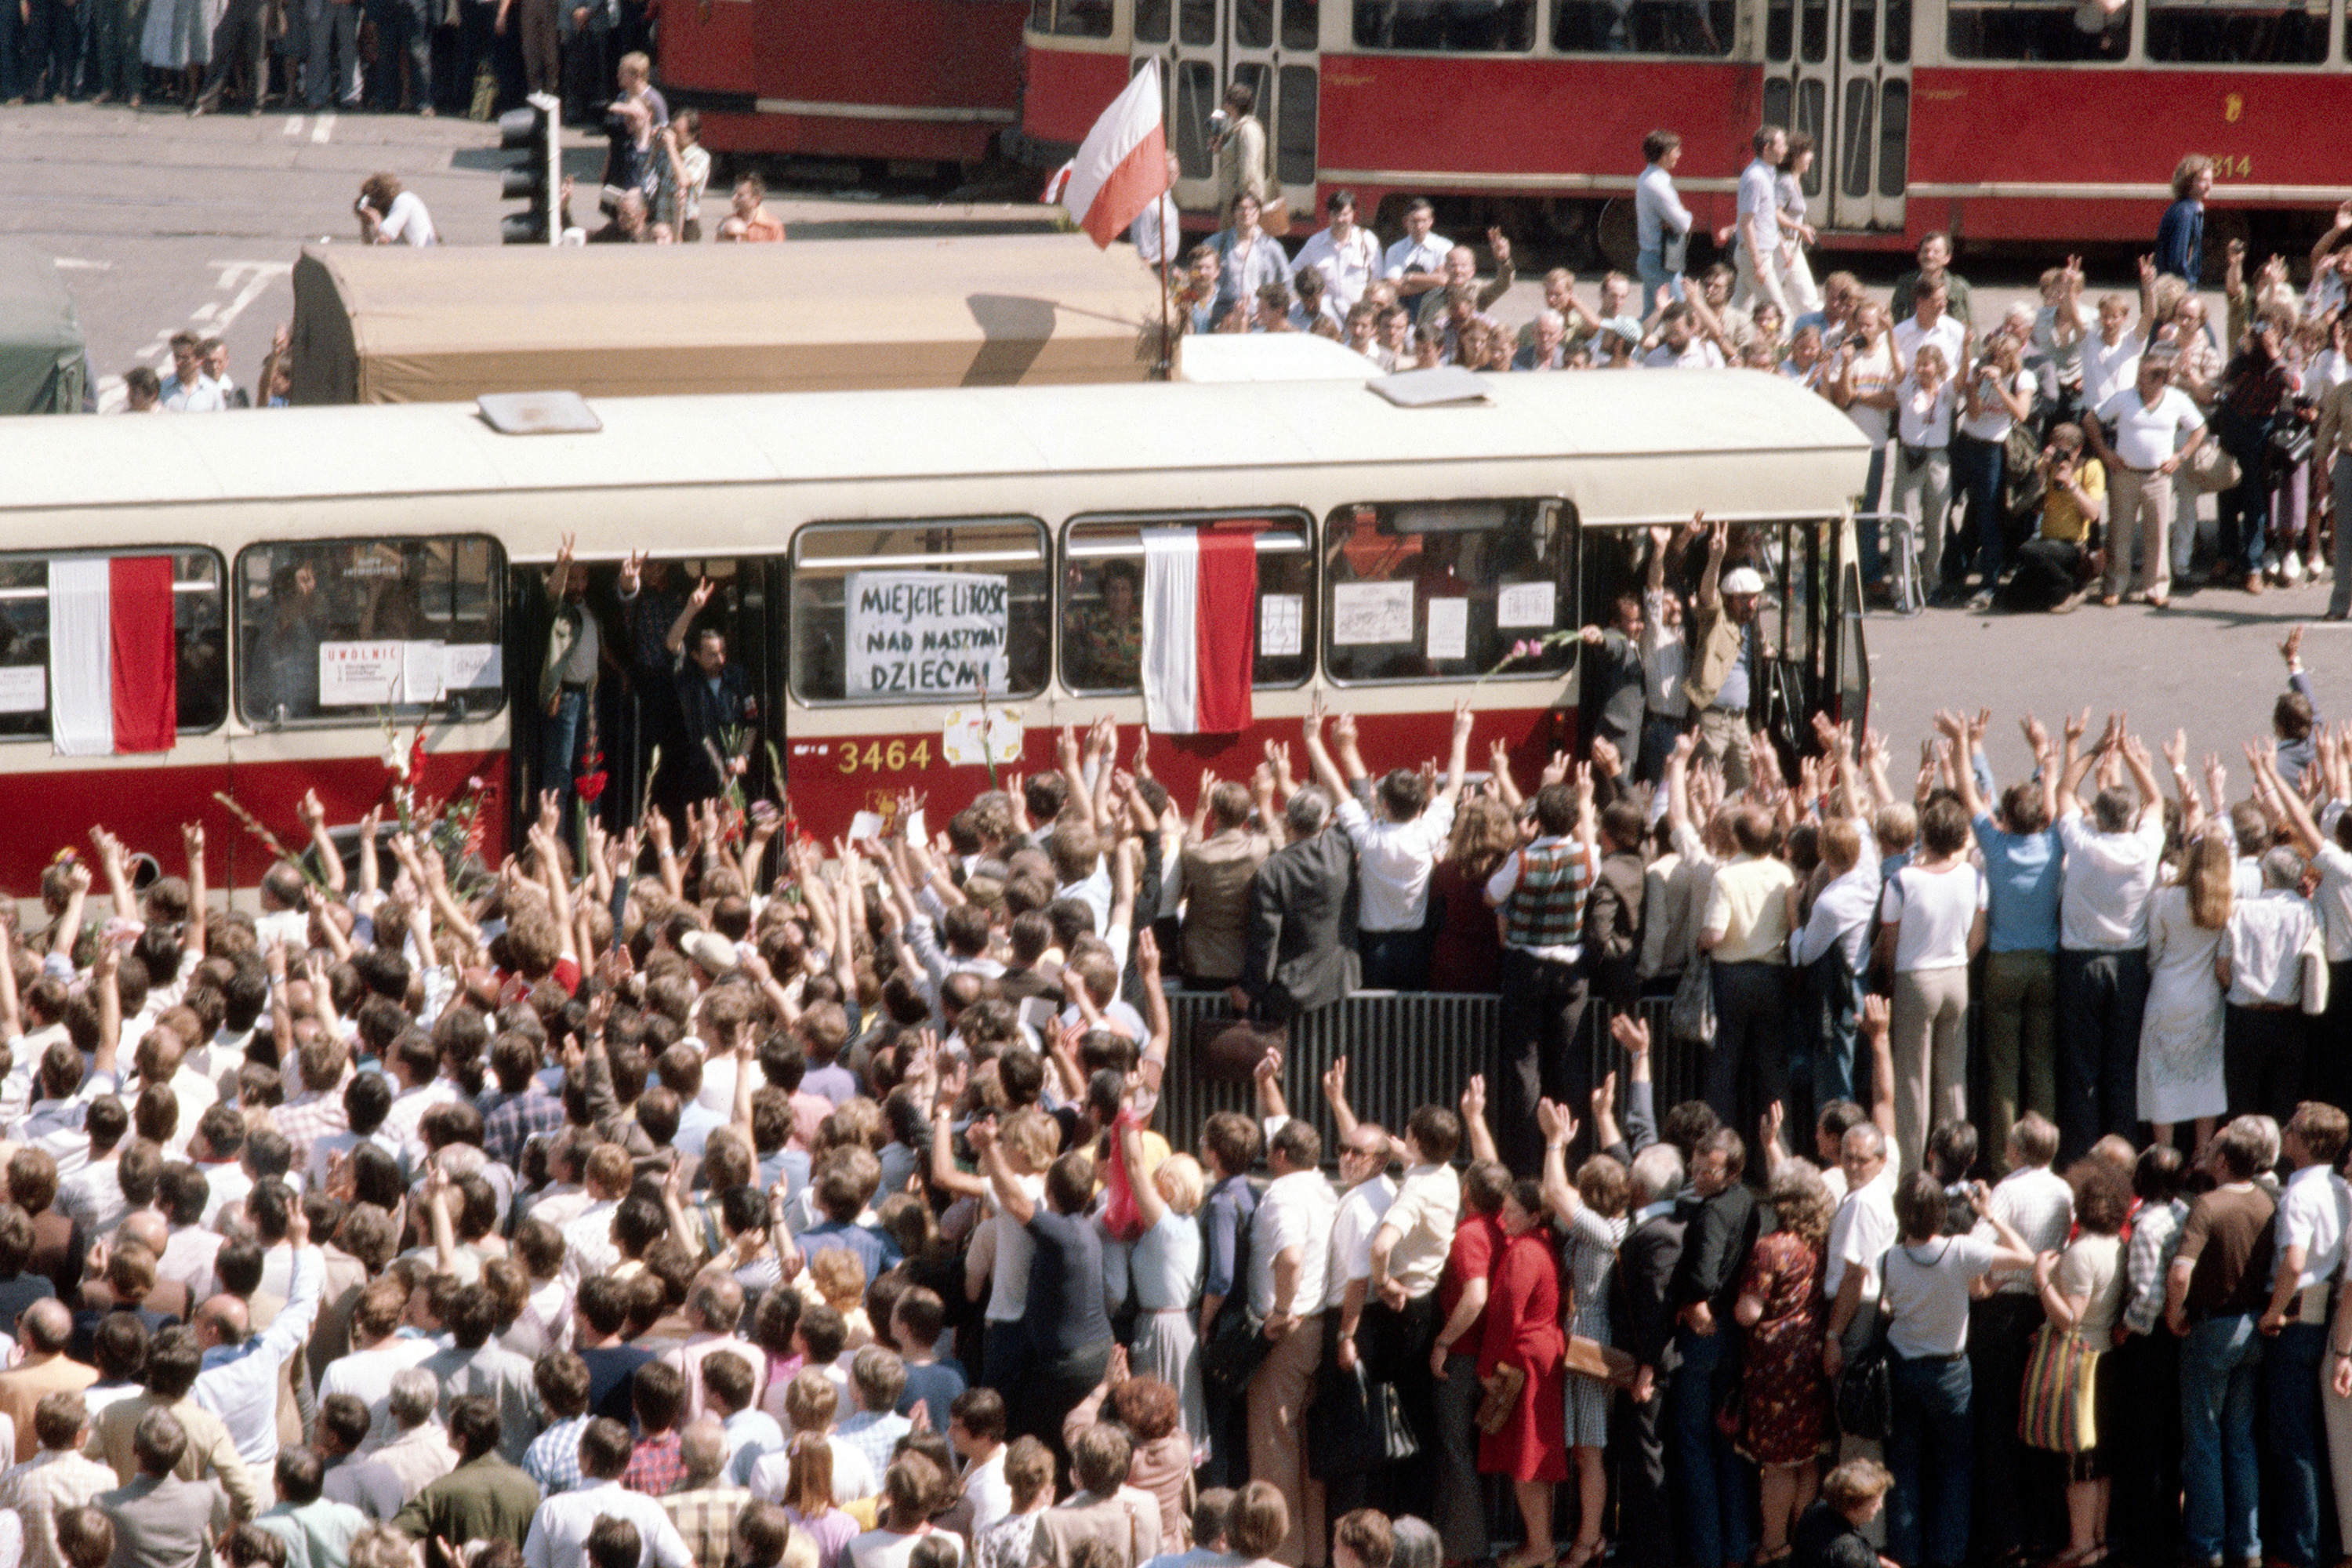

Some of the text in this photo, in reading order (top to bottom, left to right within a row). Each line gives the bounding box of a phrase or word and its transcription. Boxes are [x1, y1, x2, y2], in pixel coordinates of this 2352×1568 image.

[860, 583, 946, 624] MIEJCIE
[866, 627, 1004, 654] NAD NASZYMI
[838, 739, 931, 774] 3464
